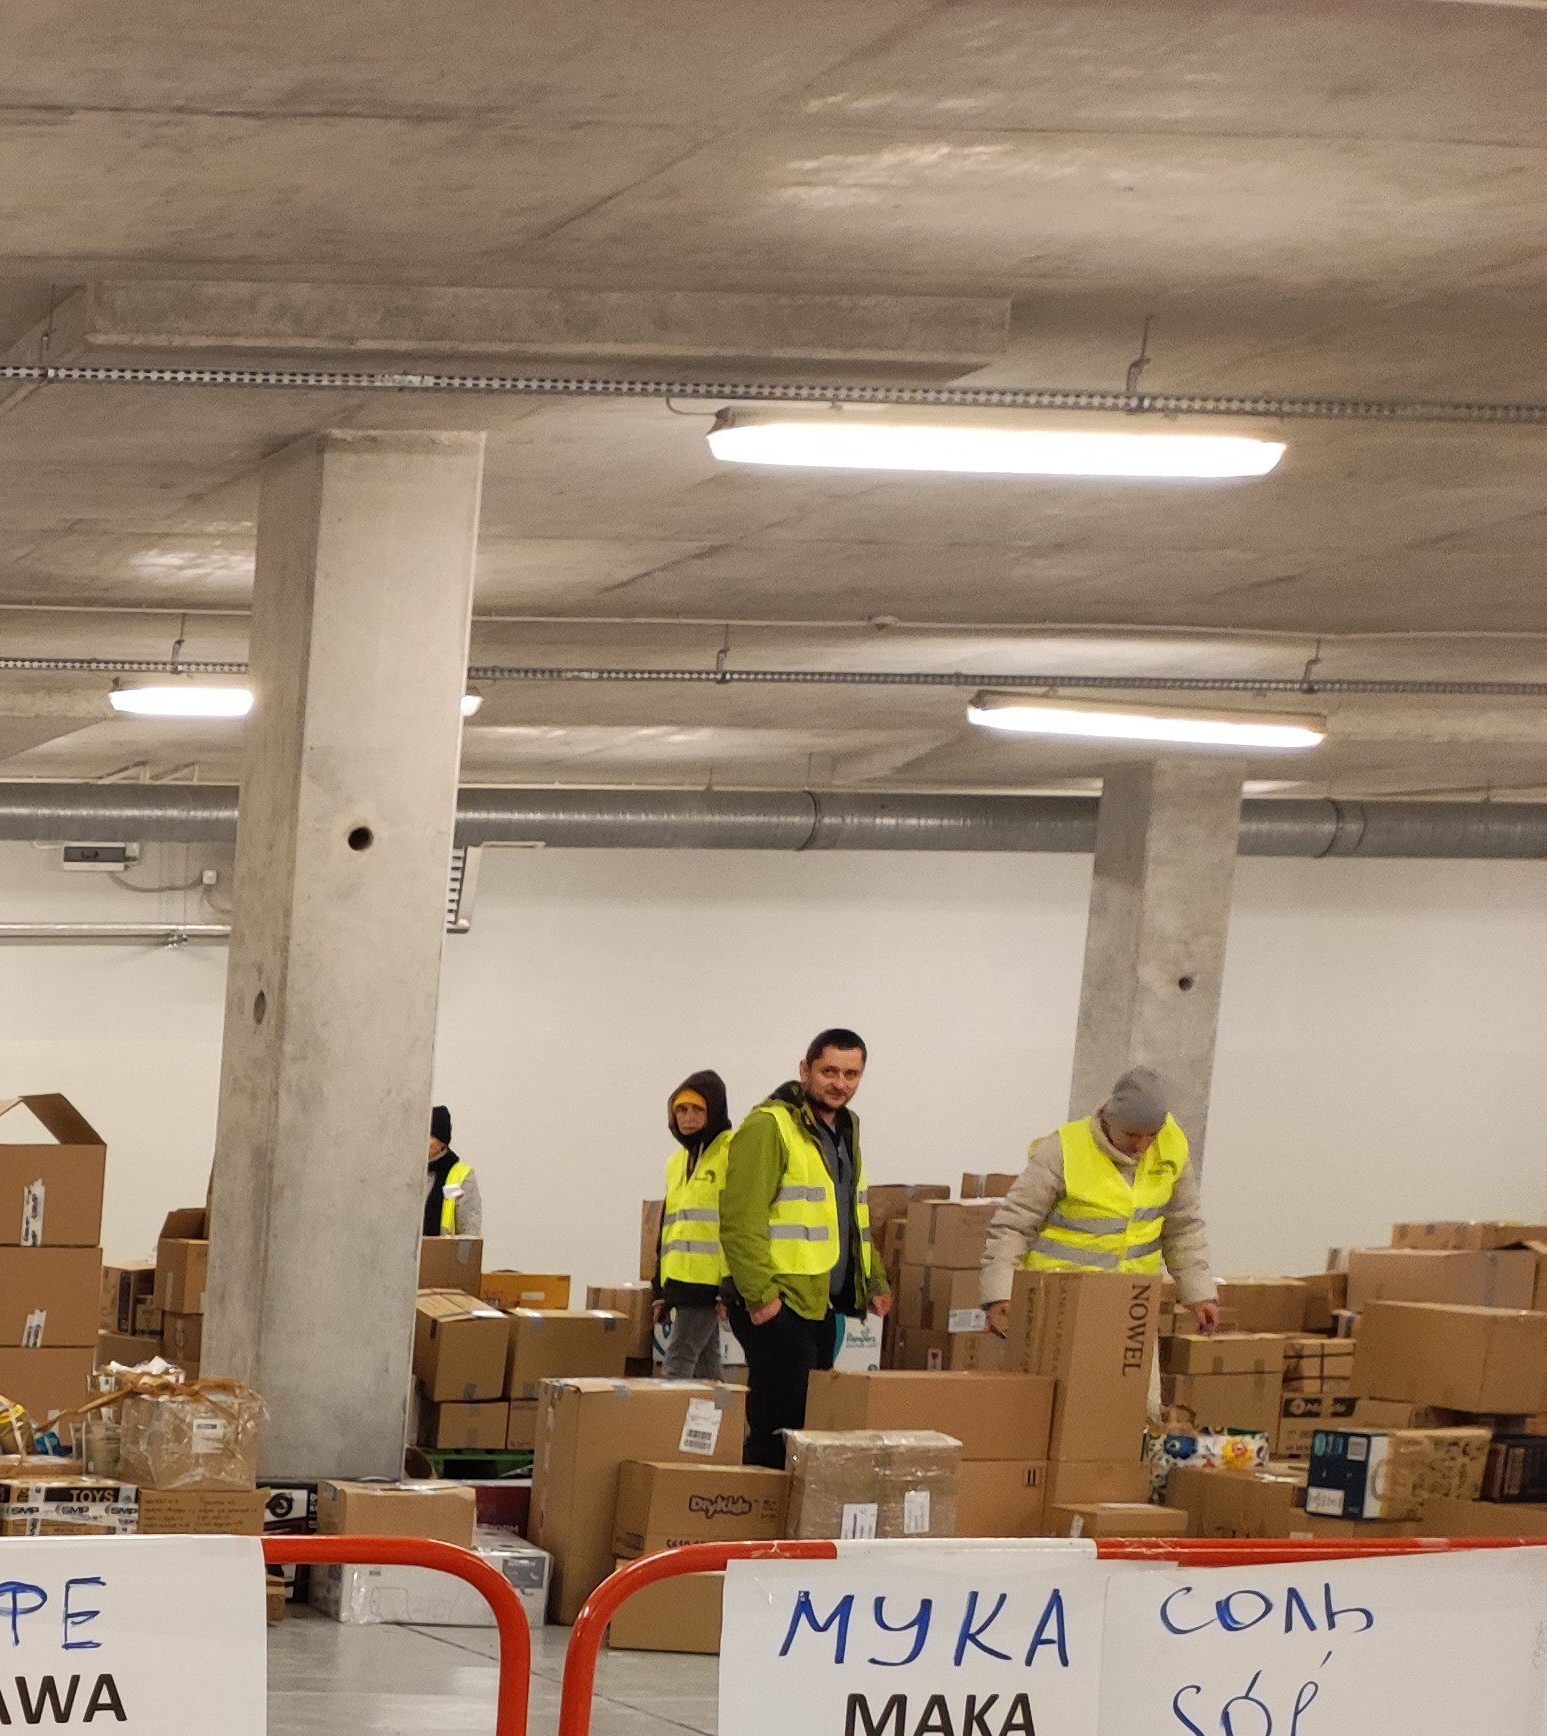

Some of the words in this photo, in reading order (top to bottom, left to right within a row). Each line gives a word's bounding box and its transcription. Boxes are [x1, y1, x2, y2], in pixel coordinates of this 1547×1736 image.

[1122, 1283, 1151, 1377] NOWEL
[70, 1489, 114, 1503] TOYS
[778, 1588, 1069, 1667] МУКА
